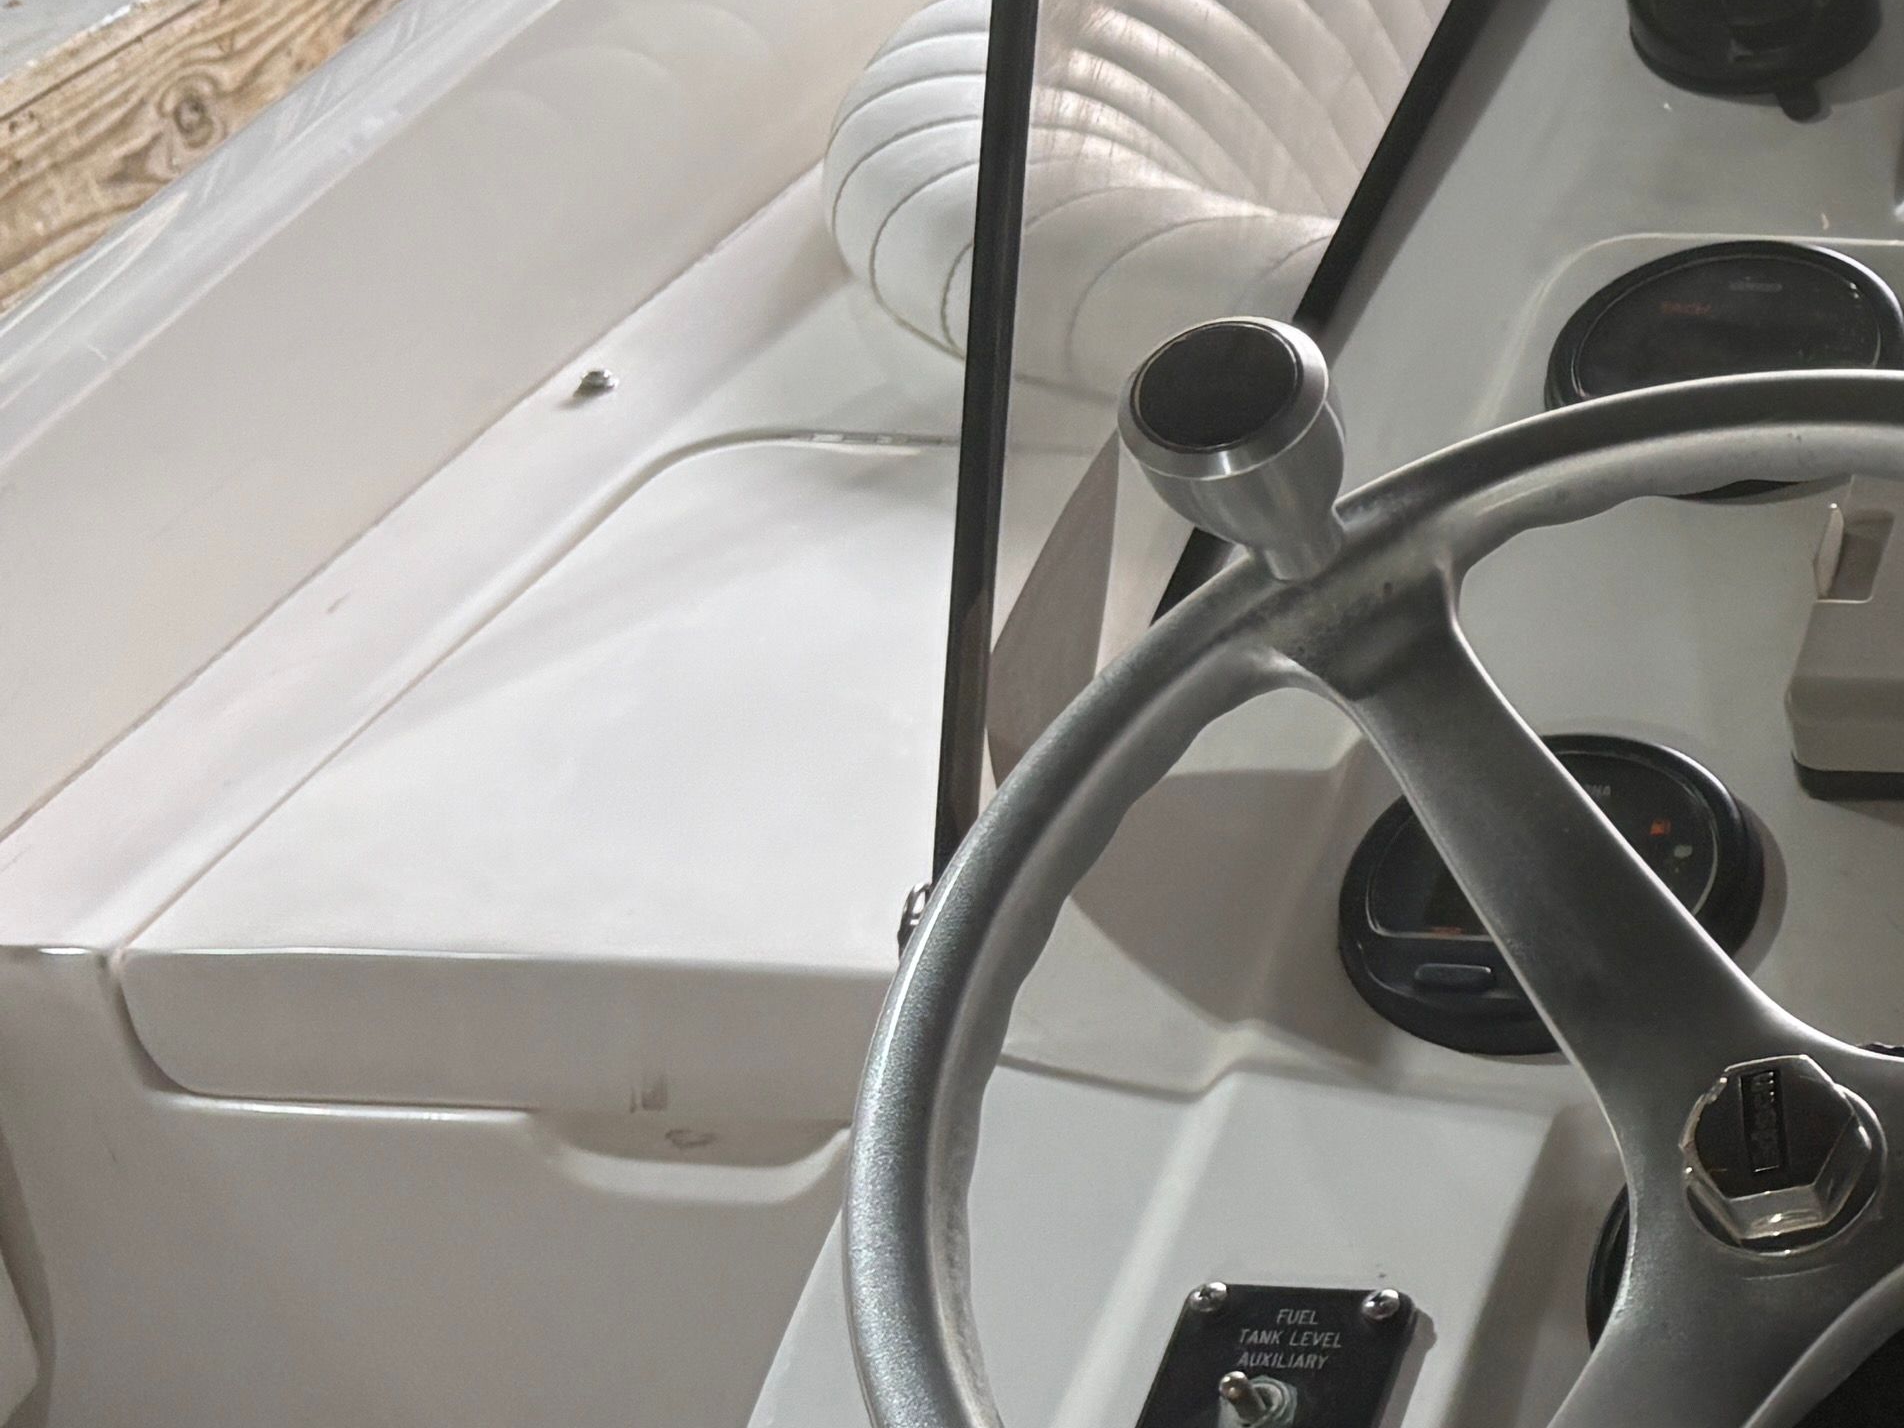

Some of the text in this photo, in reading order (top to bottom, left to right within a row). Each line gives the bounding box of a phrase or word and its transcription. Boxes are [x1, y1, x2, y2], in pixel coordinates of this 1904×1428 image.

[1276, 1309, 1318, 1325] FUEL
[1238, 1329, 1342, 1348] TANK LEVEL
[1236, 1352, 1329, 1369] AUXILIARY
